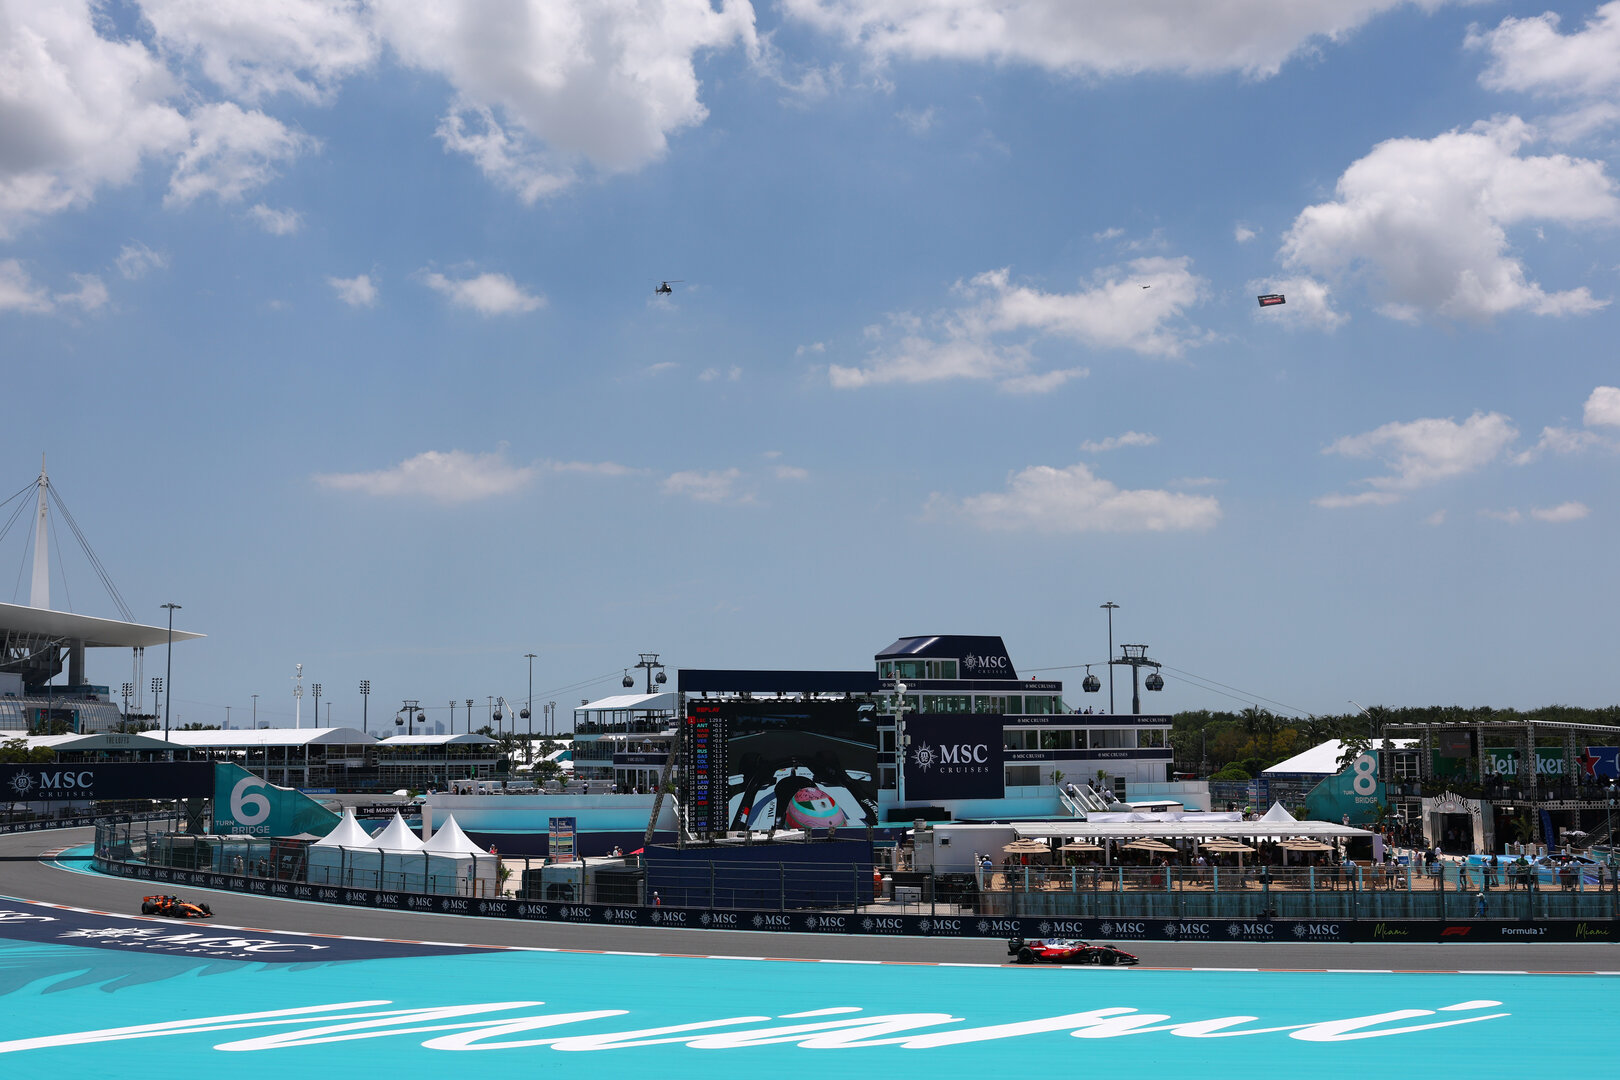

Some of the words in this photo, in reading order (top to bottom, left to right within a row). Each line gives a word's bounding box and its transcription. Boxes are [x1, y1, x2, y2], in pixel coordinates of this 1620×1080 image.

[978, 656, 1007, 668] MSC
[940, 744, 988, 763] MSC
[40, 771, 94, 788] MSC
[1354, 754, 1376, 795] 8
[230, 776, 270, 825] 6
[255, 881, 266, 890] MSC
[277, 884, 288, 892] MSC
[300, 887, 312, 895] MSC
[325, 890, 337, 898] MSC
[353, 892, 367, 901] MSC
[382, 894, 398, 903] MSC
[416, 897, 432, 906] MSC
[450, 900, 468, 909] MSC
[488, 902, 507, 912] MSC
[527, 905, 548, 914] MSC
[570, 907, 591, 917] MSC
[615, 910, 637, 919] MSC
[663, 912, 686, 921] MSC
[713, 914, 737, 923] MSC
[765, 915, 790, 925] MSC
[819, 916, 845, 927] MSC
[876, 919, 903, 928] MSC
[933, 920, 960, 930] MSC
[992, 921, 1020, 931] MSC
[1054, 922, 1083, 932] MSC
[1116, 923, 1145, 933] MSC
[1180, 924, 1209, 934] MSC
[1243, 924, 1274, 934] MSC
[1309, 924, 1340, 934] MSC
[1374, 922, 1408, 938] Miami
[1576, 923, 1610, 938] Miami
[134, 932, 330, 953] MSC
